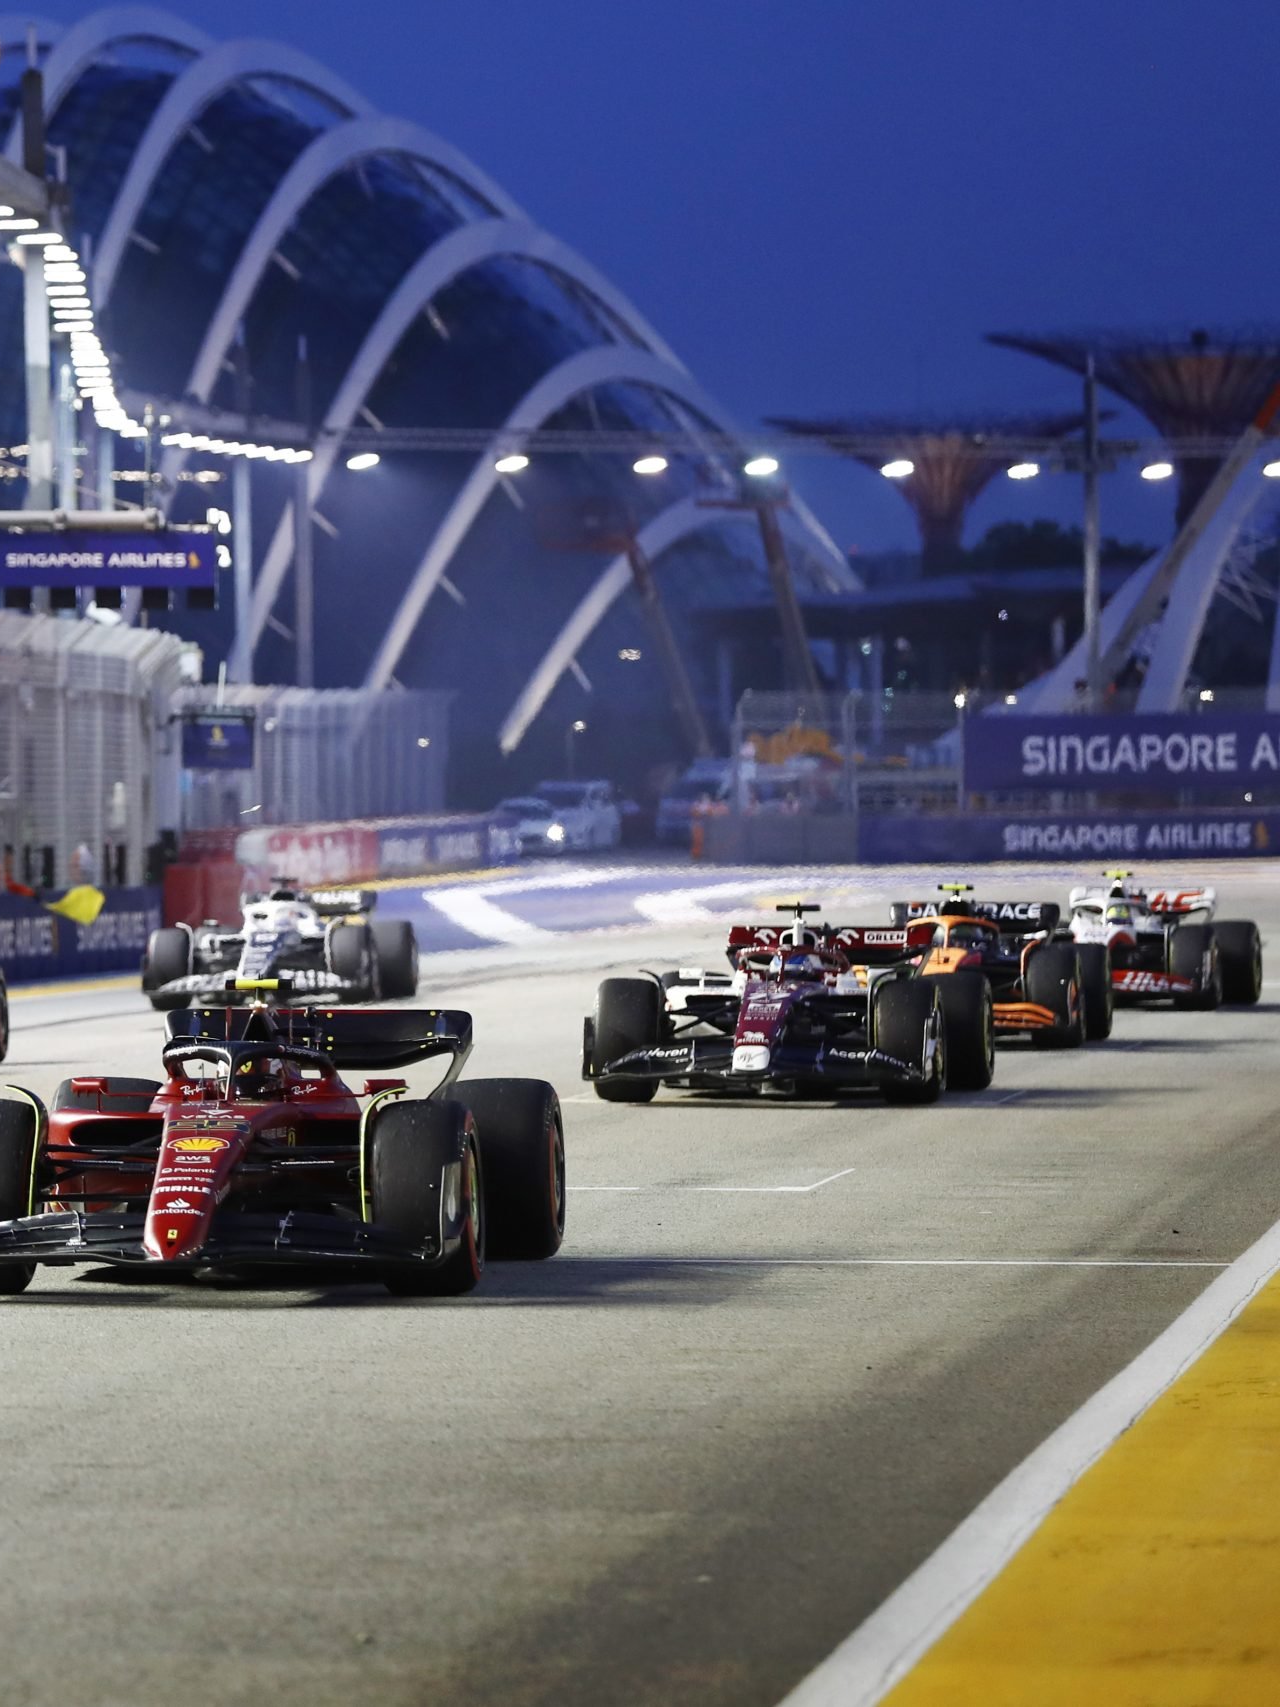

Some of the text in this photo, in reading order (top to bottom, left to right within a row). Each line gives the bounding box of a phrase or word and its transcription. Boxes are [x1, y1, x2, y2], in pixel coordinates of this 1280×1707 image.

[5, 552, 187, 569] SINGAPORE AIRLINES
[1022, 733, 1238, 776] SINGAPORE
[1003, 822, 1253, 852] SINGAPORE AIRLINES
[866, 932, 906, 942] ORLEN
[155, 1185, 211, 1195] MAHLE
